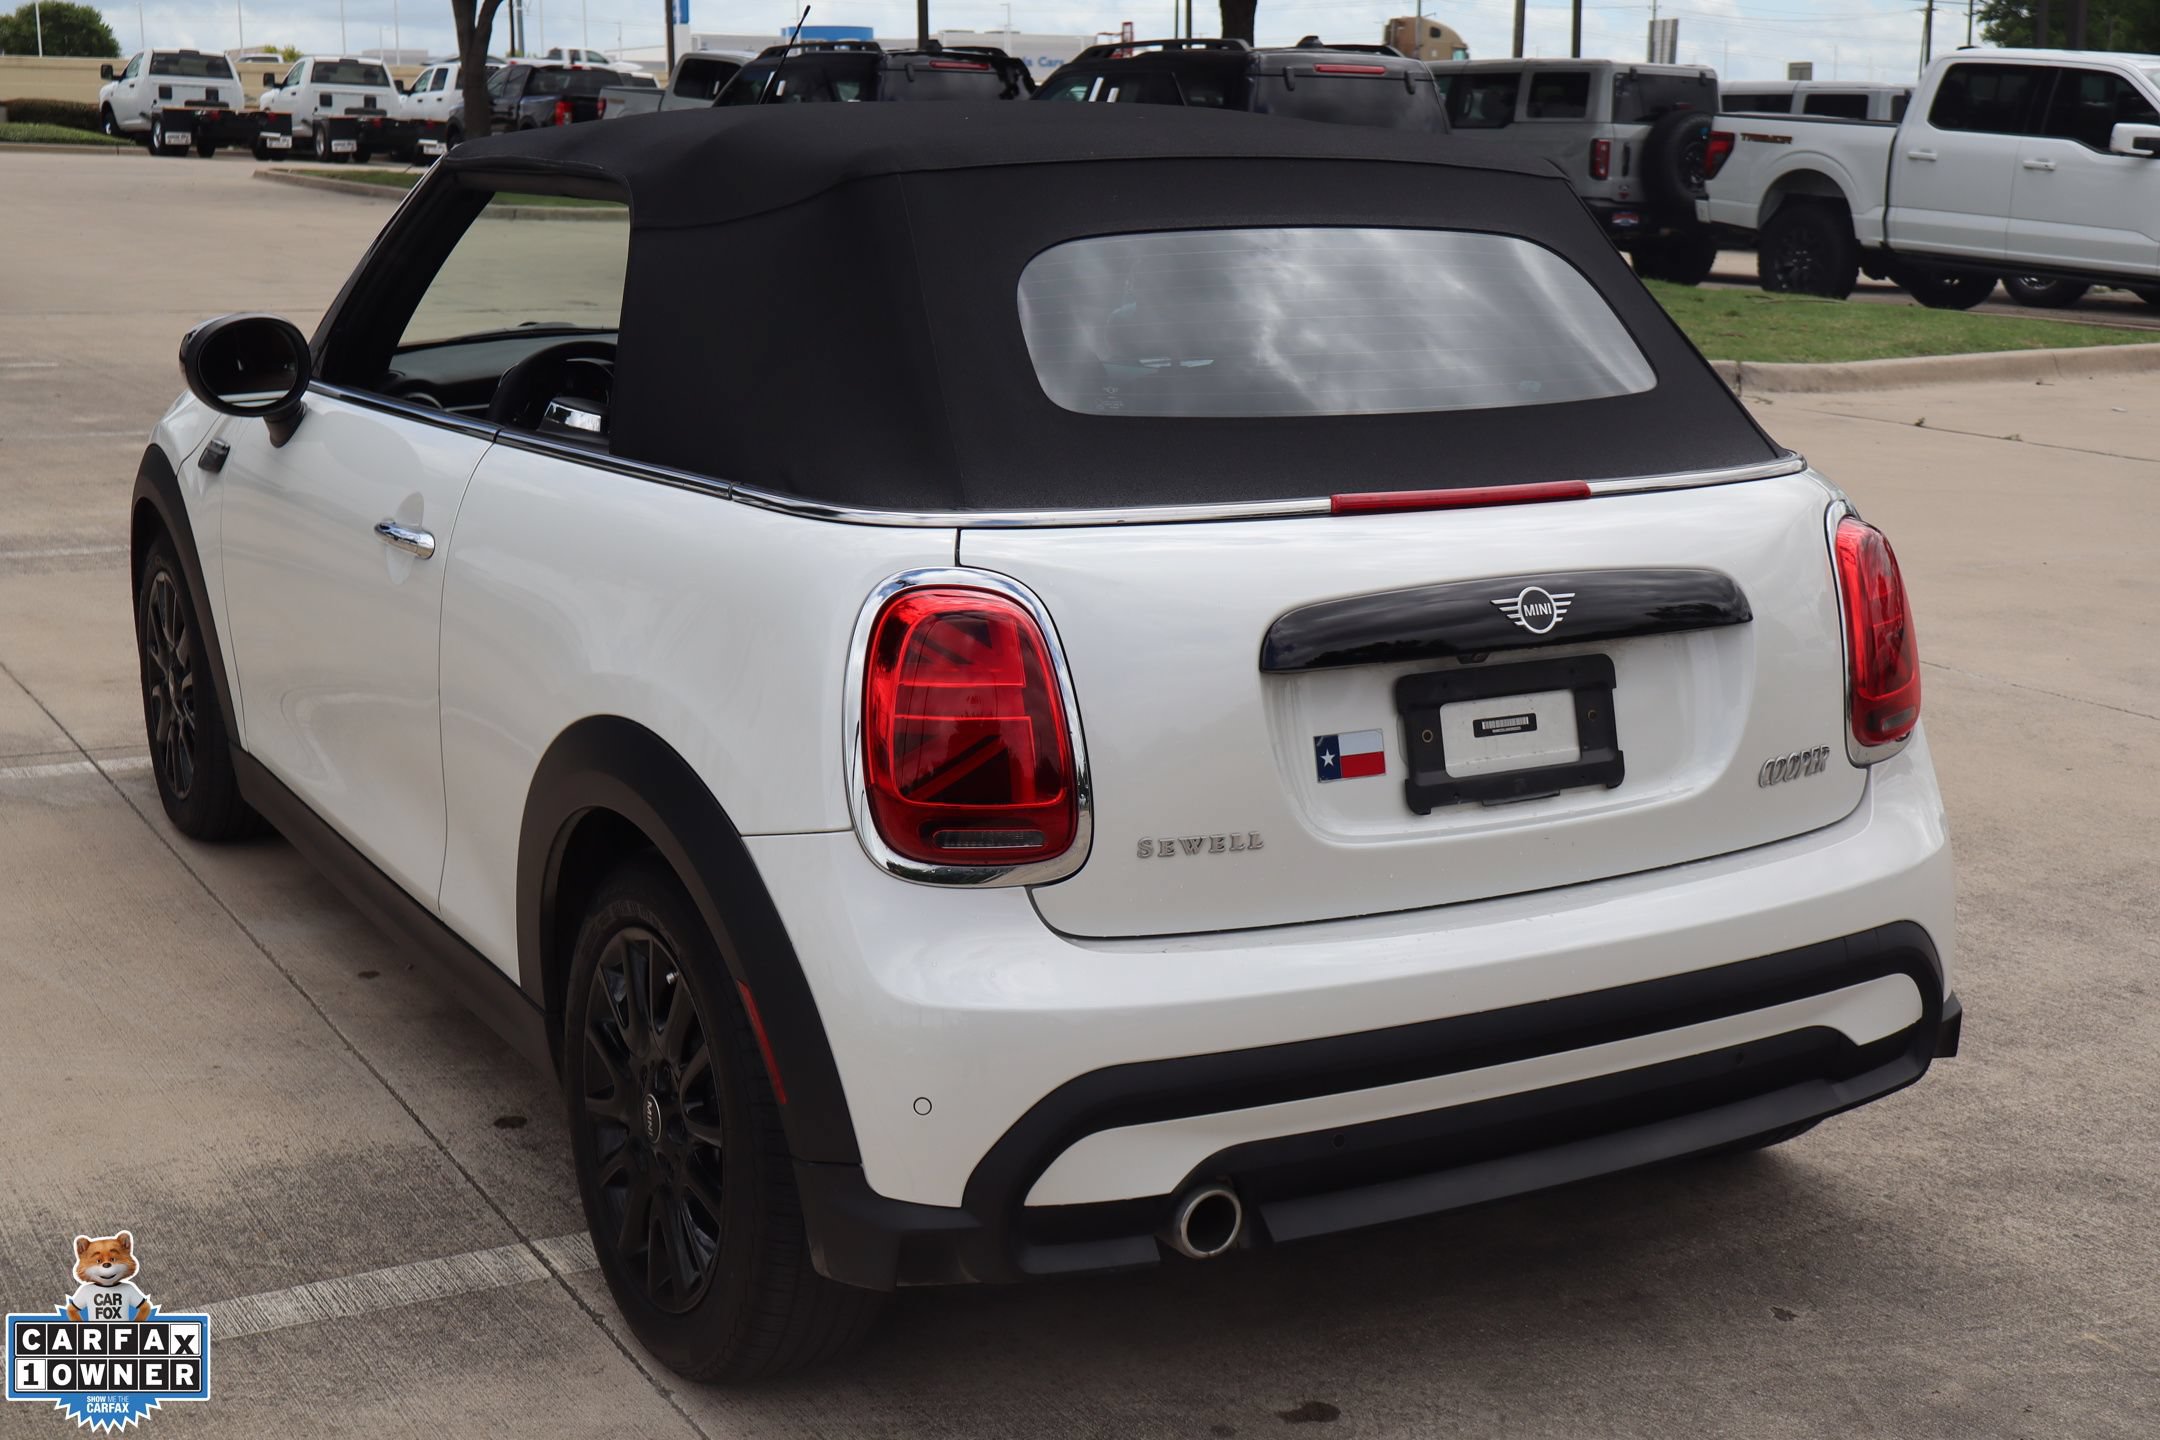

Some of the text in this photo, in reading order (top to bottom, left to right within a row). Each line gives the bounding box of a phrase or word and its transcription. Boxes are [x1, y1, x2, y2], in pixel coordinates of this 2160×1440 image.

[1523, 602, 1553, 617] MINI
[1758, 744, 1830, 788] COOPER
[1136, 830, 1265, 858] SEWELL
